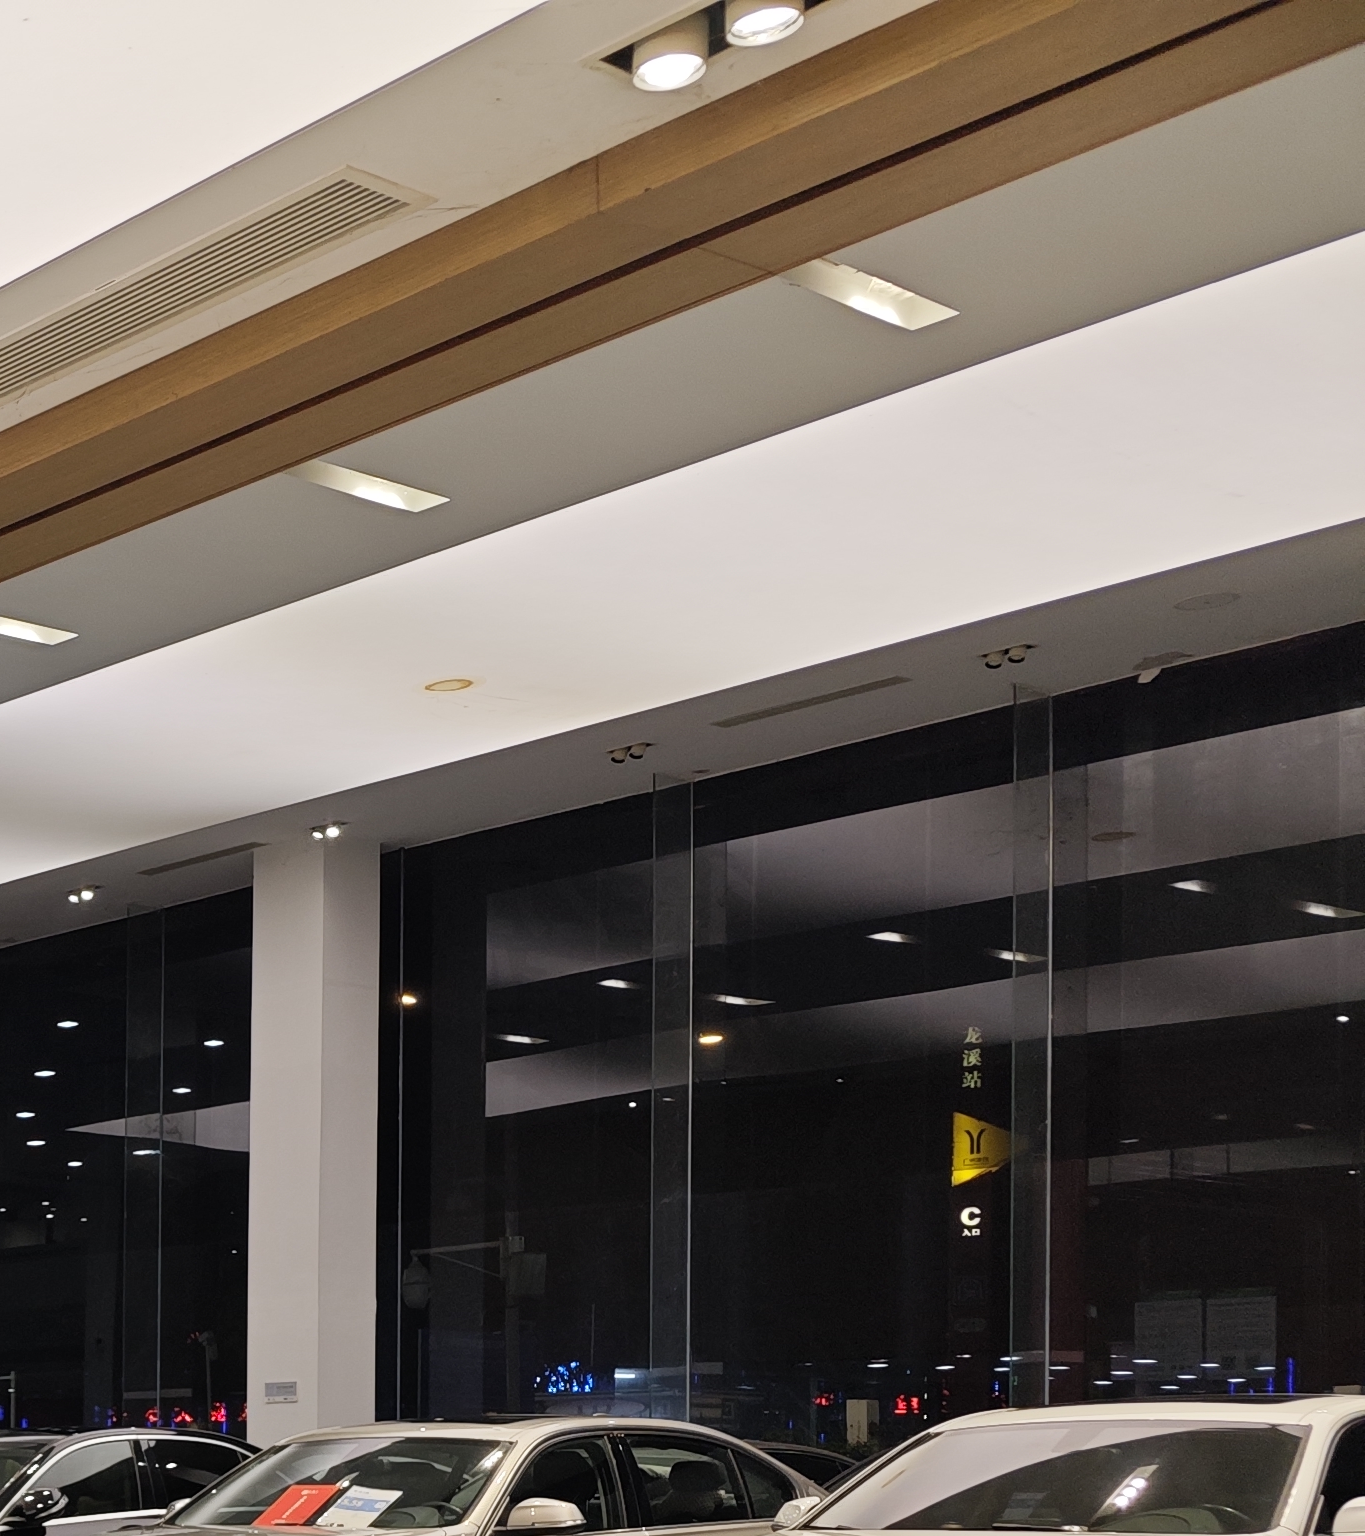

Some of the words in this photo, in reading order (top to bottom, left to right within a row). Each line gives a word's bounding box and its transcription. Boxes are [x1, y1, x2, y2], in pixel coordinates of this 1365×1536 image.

[961, 1026, 983, 1089] 龙溪站
[960, 1206, 982, 1226] C
[961, 1228, 981, 1237] 入口
